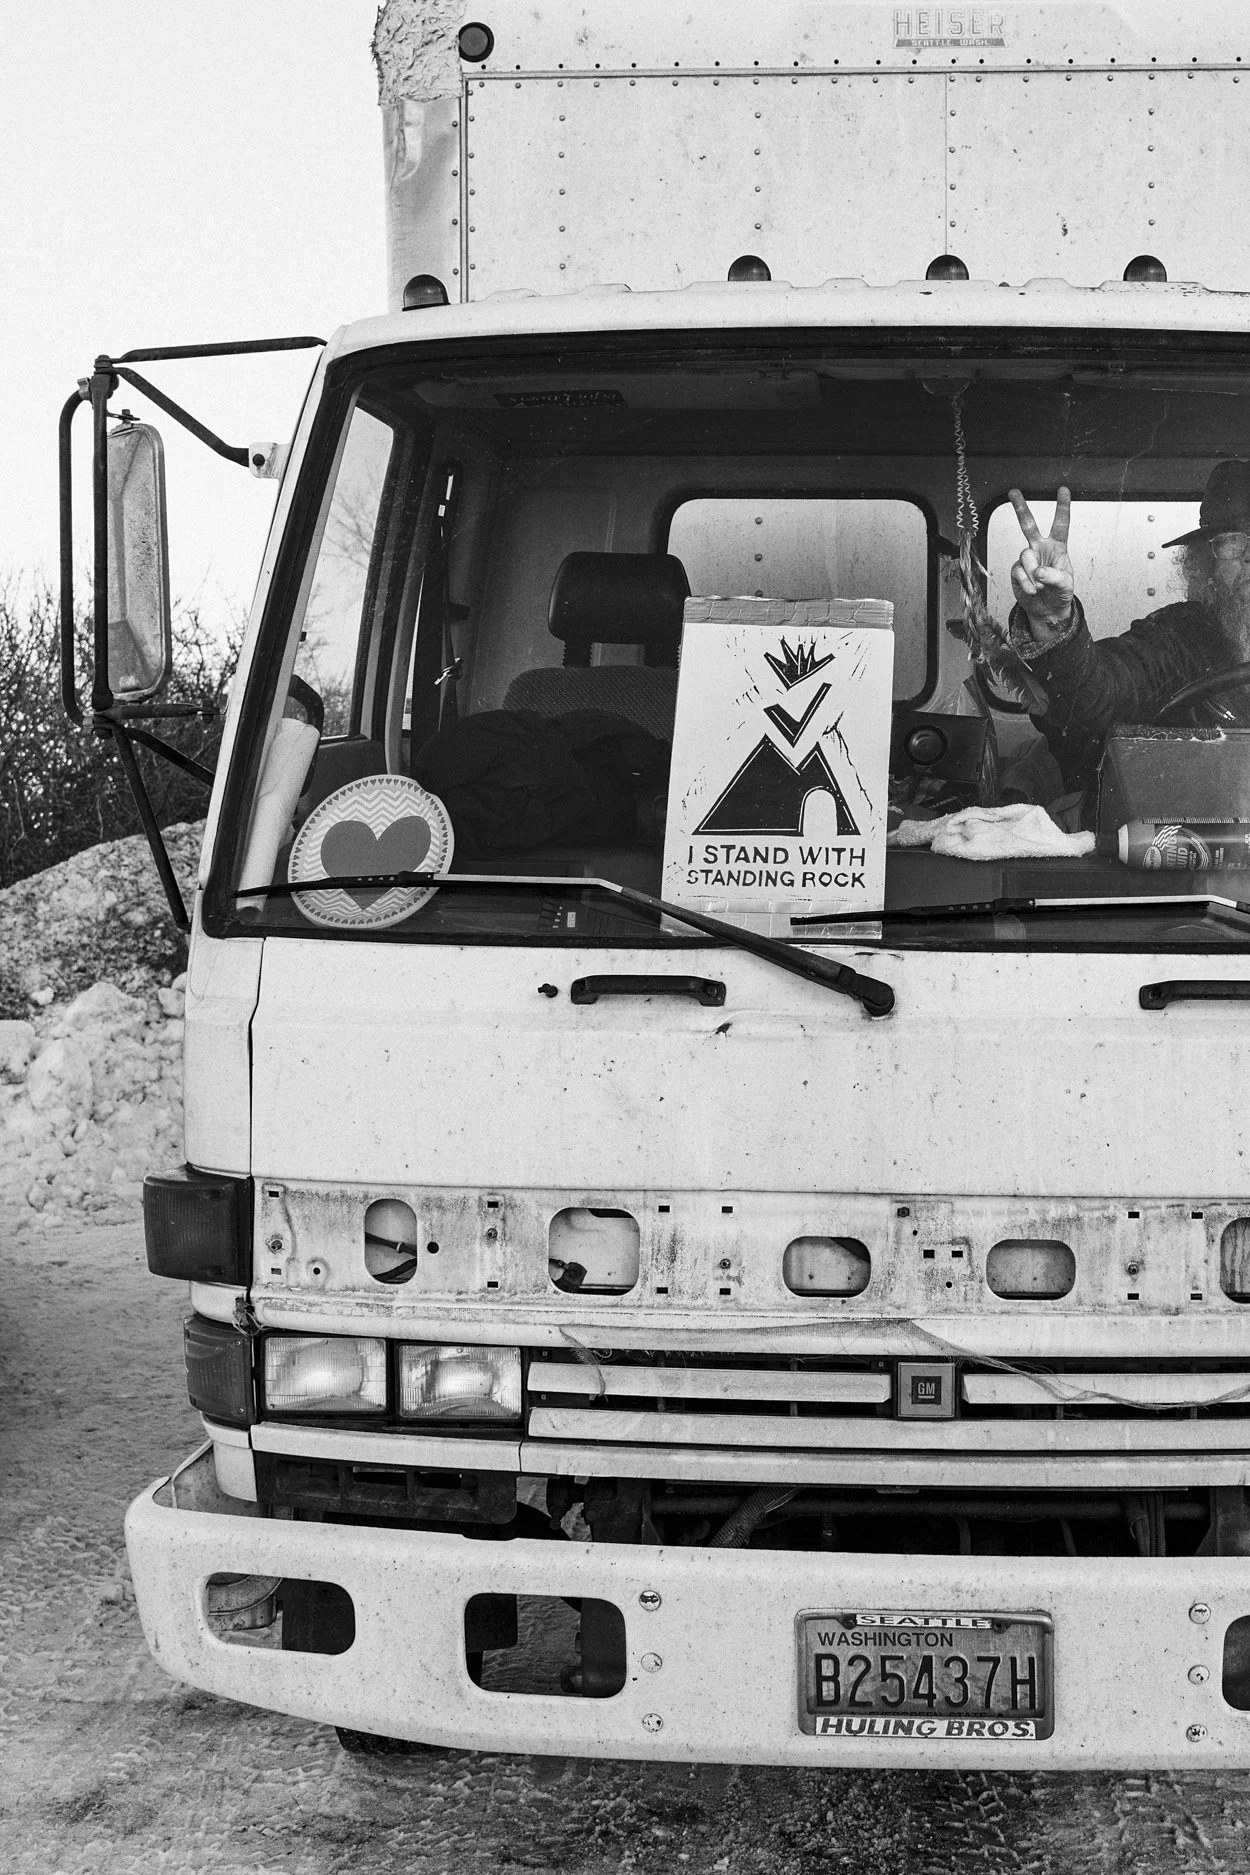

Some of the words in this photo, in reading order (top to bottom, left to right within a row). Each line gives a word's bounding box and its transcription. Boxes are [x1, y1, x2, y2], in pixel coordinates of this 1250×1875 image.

[894, 9, 1005, 37] HEISER
[688, 845, 694, 865] I
[703, 844, 790, 865] STAND
[799, 846, 866, 867] WITH
[686, 869, 795, 887] STANDING
[802, 871, 866, 889] ROCK
[917, 1382, 935, 1395] GM
[860, 1615, 988, 1628] SEATTLE
[817, 1631, 954, 1647] WASHINGTON
[814, 1653, 1037, 1710] B25437H
[820, 1717, 937, 1737] HULING
[945, 1720, 1035, 1738] BROS.
